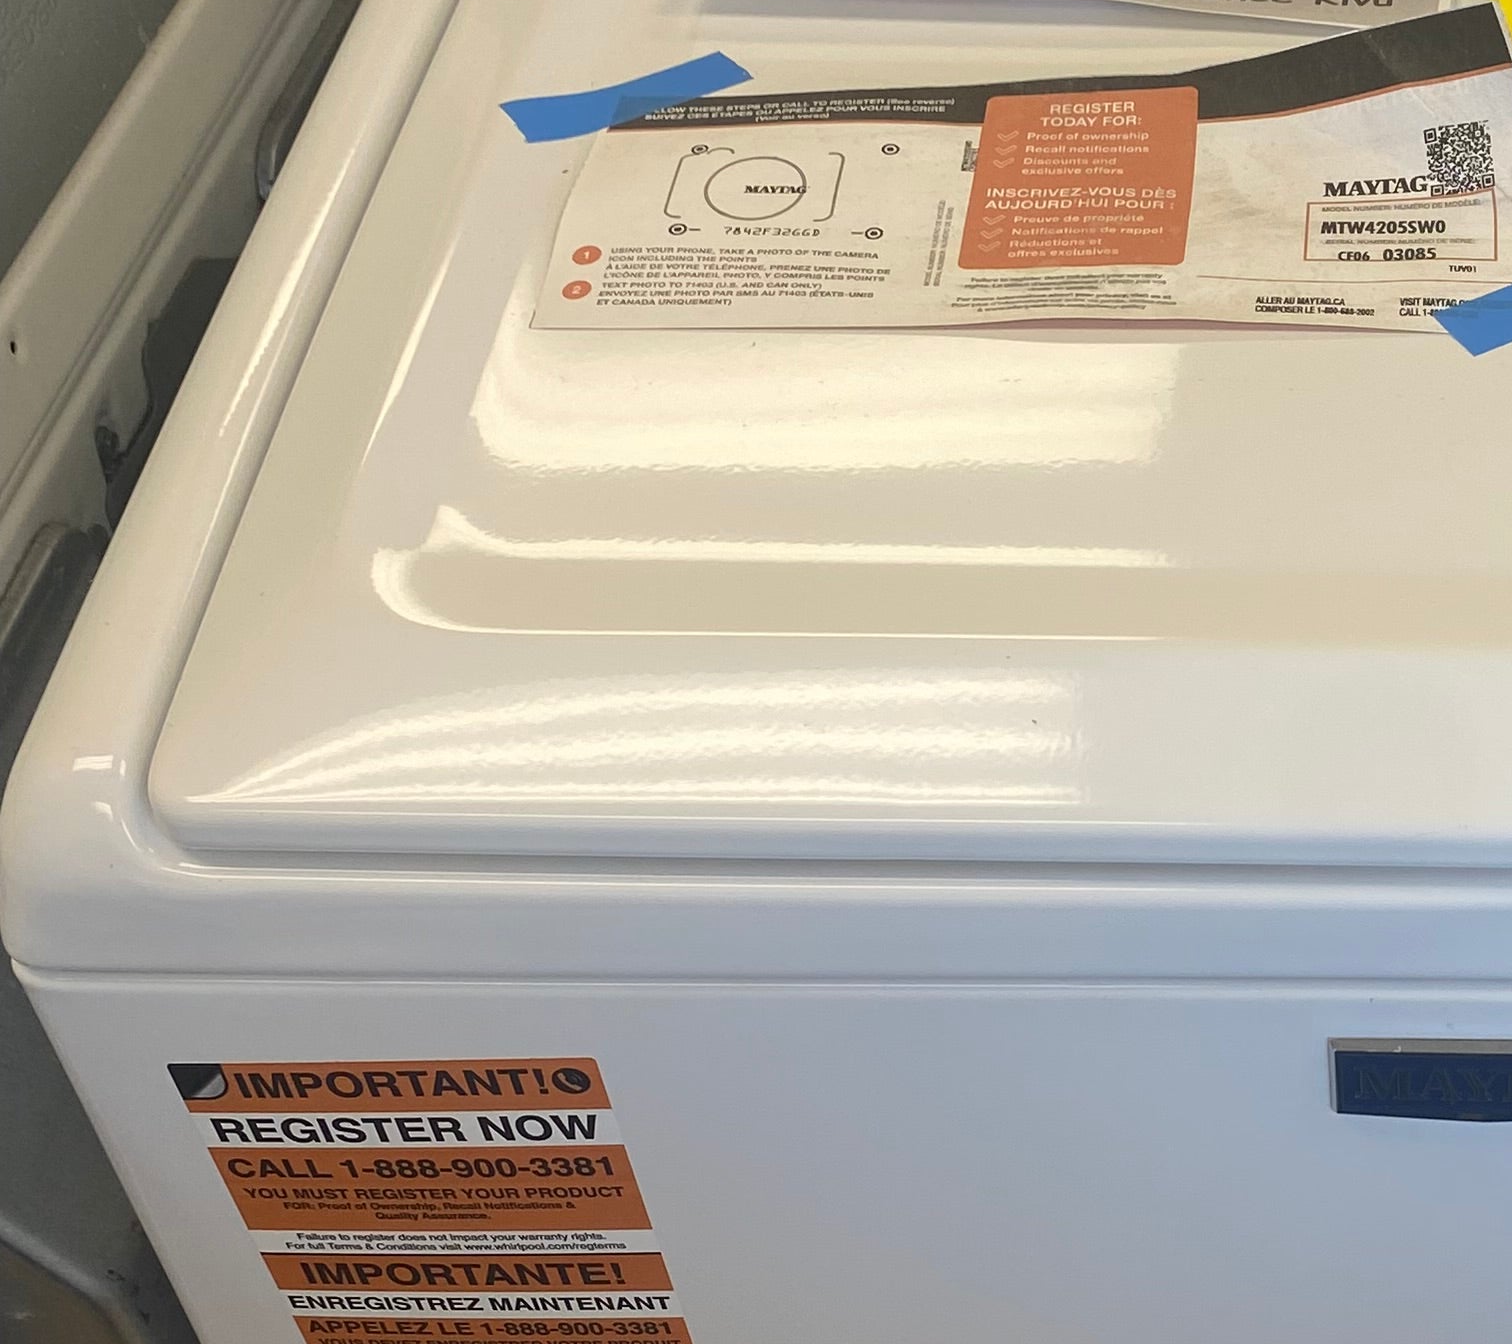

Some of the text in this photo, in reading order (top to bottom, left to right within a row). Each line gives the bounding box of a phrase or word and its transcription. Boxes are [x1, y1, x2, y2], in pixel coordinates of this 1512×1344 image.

[1050, 102, 1135, 115] REGISTER
[1040, 116, 1142, 127] TODAY FOR:
[1026, 132, 1150, 142] Proof of ownership
[744, 185, 807, 194] MAYTAG
[986, 186, 1176, 199] INSCRIVEZ-VOUS DÈS
[1323, 176, 1429, 197] MAYTAG
[985, 198, 1164, 210] AUJOURD'HUI POUR
[1321, 220, 1446, 235] MTW4205SW0
[1338, 248, 1437, 262] CF06 03085
[233, 1068, 549, 1098] IMPORTANT!
[210, 1114, 597, 1143] REGISTER NOW
[227, 1156, 614, 1178] CALL 1-888-900-3381
[243, 1186, 624, 1200] YOU MUST REGISTER YOUR PRODUCT
[300, 1262, 626, 1286] IMPORTANTE!
[287, 1295, 671, 1311] ENREGISTREZ MAINTENANT
[309, 1320, 672, 1336] APPELEZ LE 1-888-900-3381
